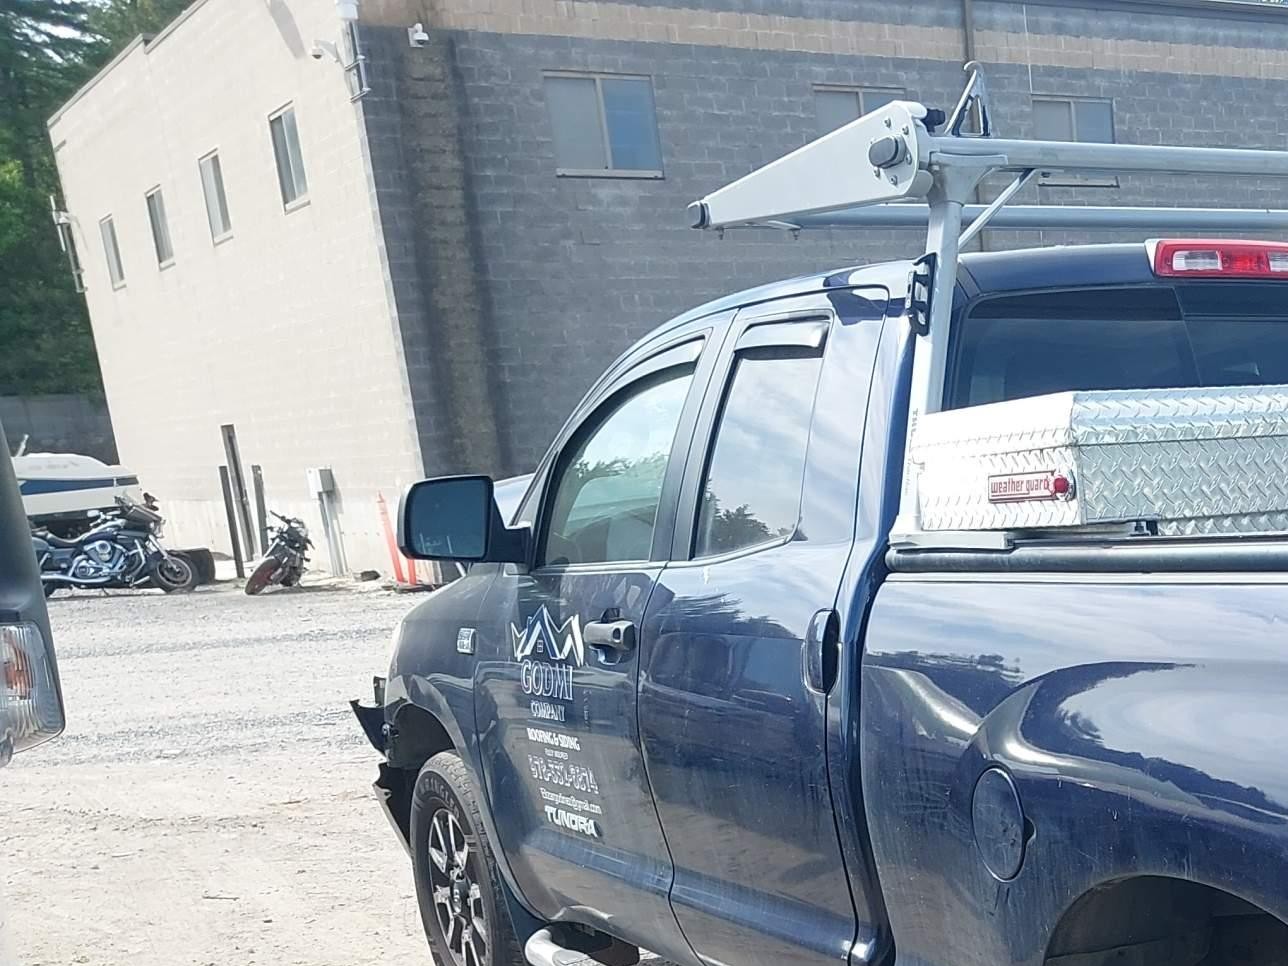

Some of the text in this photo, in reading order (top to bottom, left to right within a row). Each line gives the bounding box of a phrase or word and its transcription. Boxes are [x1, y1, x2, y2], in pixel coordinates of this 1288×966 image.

[990, 476, 1049, 494] weather guard
[544, 804, 599, 839] TUNDRA
